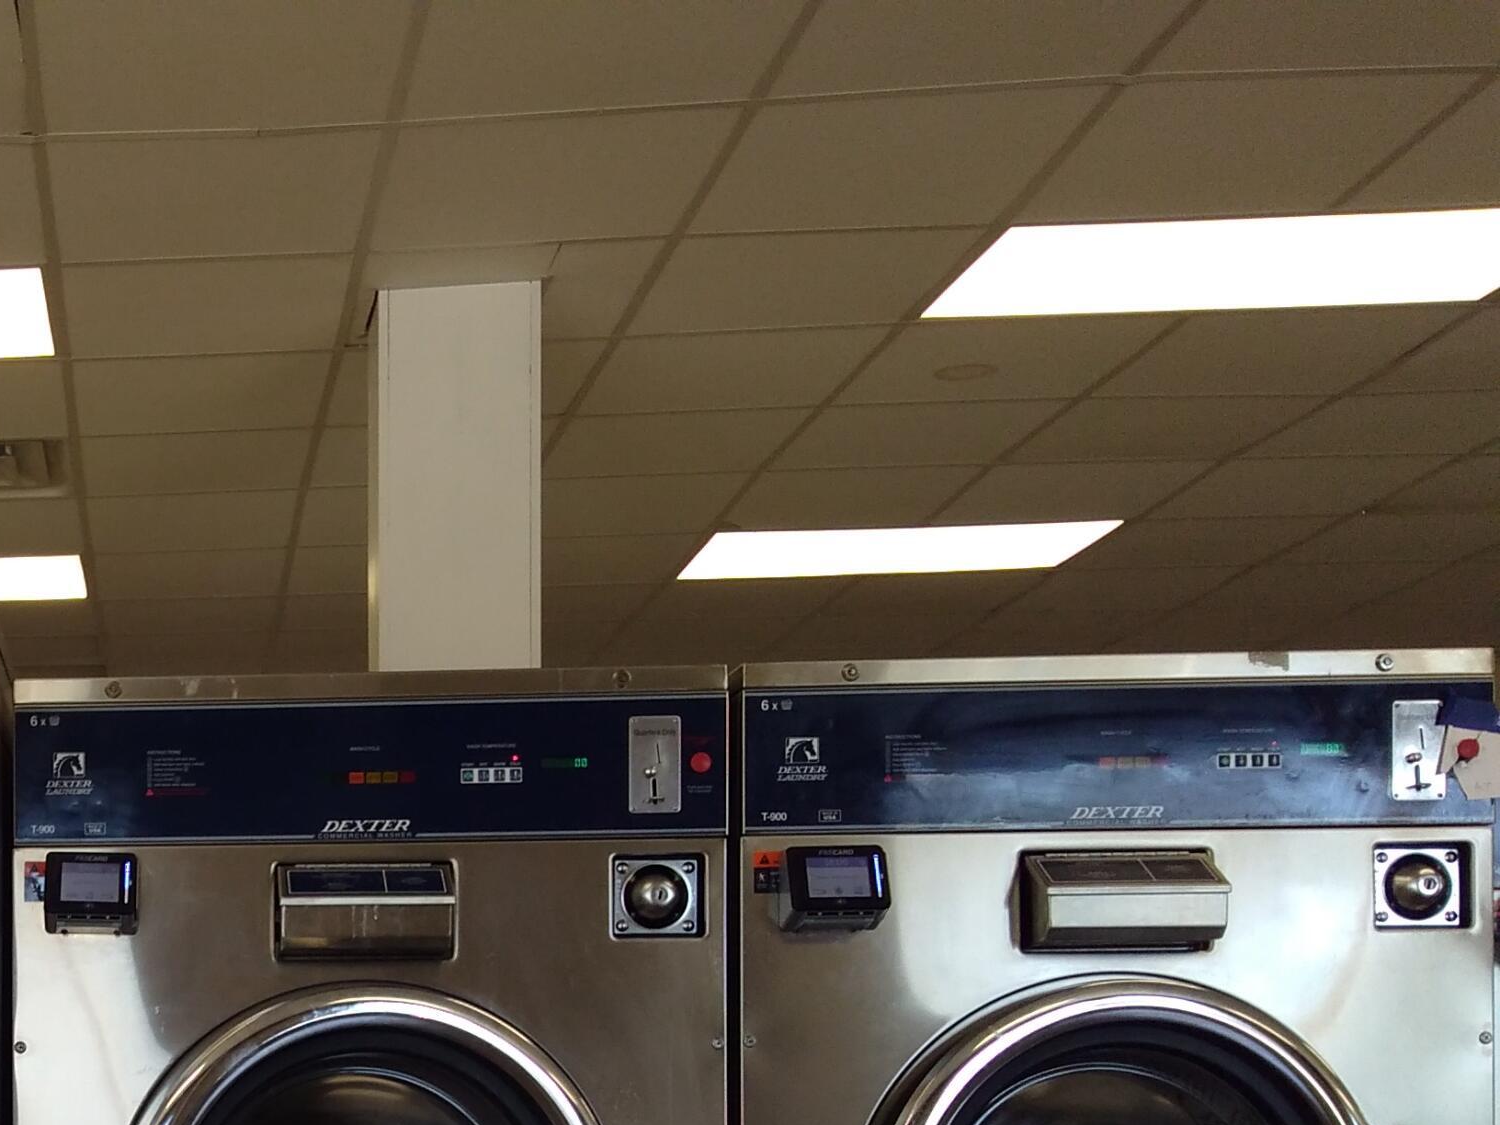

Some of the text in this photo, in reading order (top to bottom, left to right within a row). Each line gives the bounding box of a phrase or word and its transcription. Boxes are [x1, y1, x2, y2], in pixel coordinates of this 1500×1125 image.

[761, 699, 769, 711] 6
[29, 715, 38, 727] 6
[777, 765, 827, 774] DEXTER
[45, 779, 92, 788] DEXTER
[761, 811, 788, 821] T-900
[1070, 805, 1164, 819] DEXTER
[30, 824, 55, 834] T-900
[321, 819, 411, 833] DEXTER
